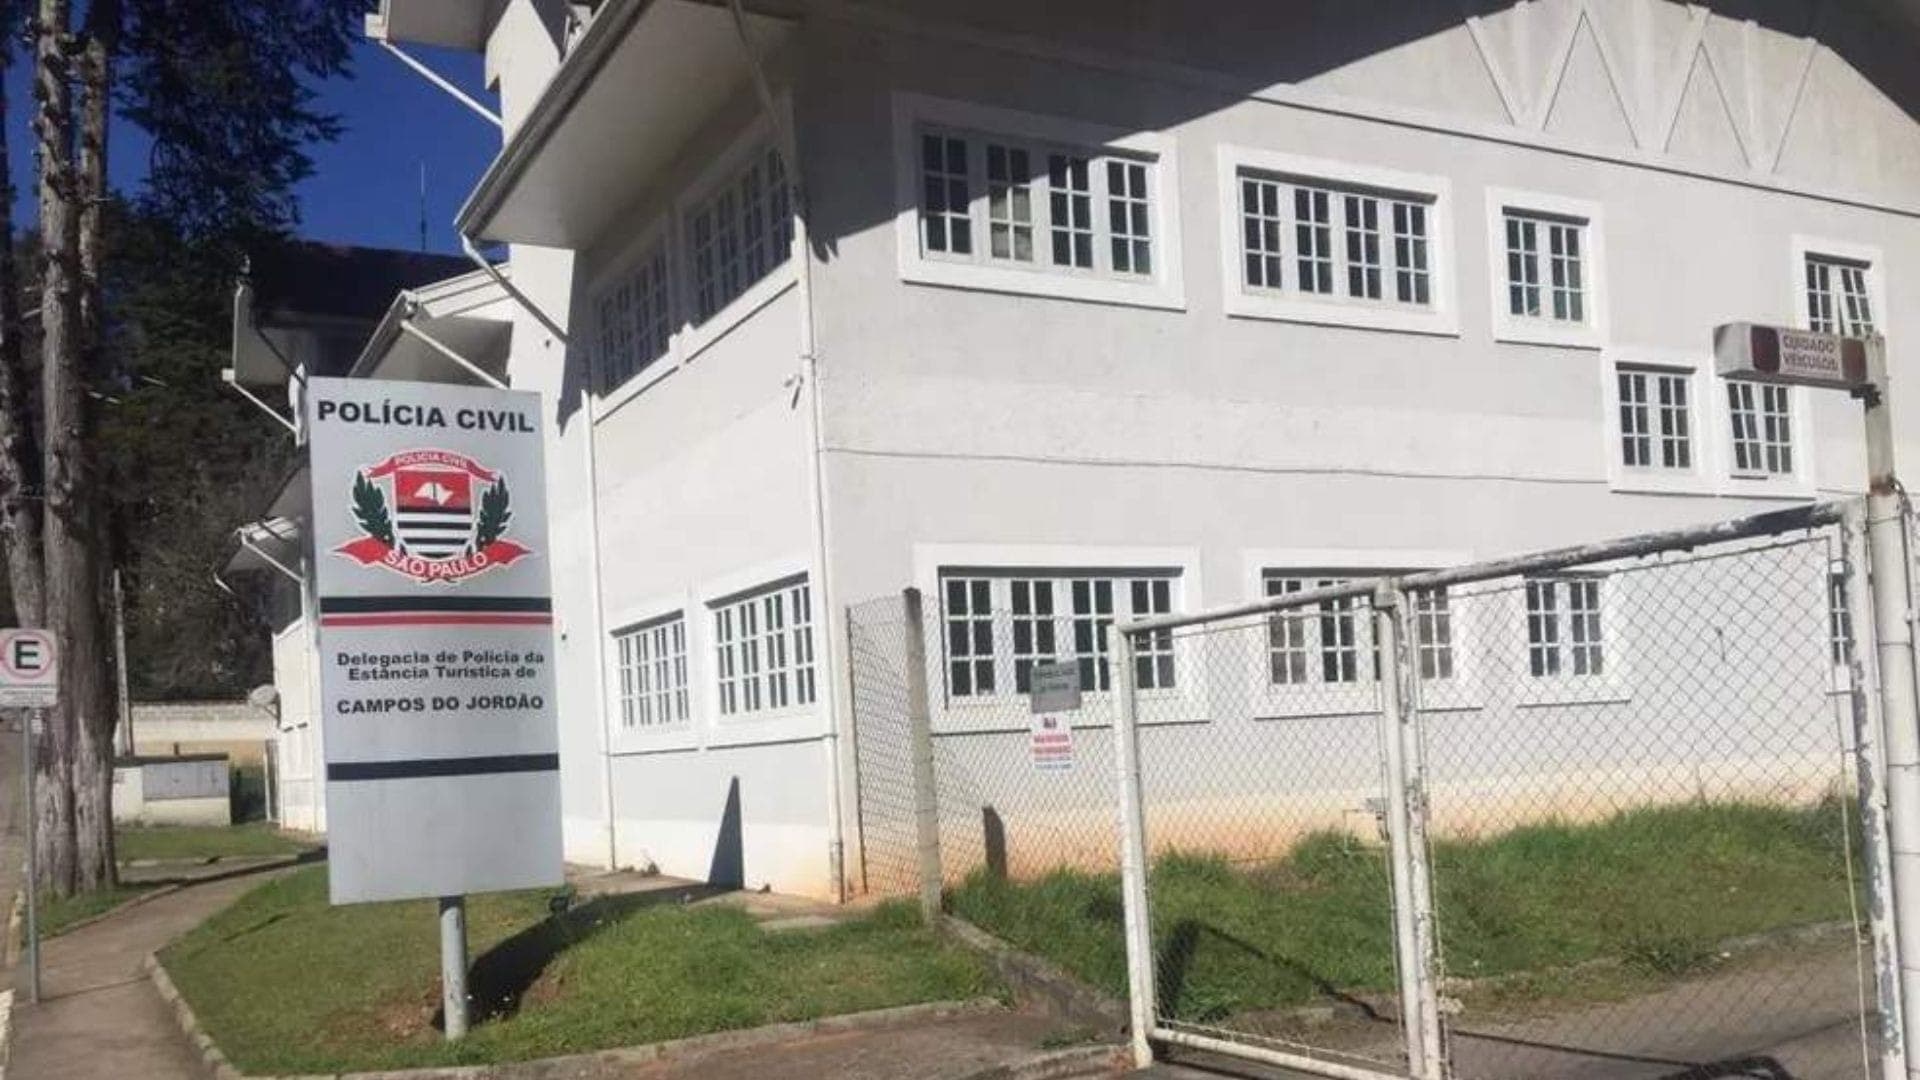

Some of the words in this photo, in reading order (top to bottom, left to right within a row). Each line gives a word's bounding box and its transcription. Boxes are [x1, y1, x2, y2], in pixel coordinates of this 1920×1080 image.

[318, 399, 446, 427] POLÍCIA
[457, 409, 535, 432] CIVIL
[429, 551, 487, 577] PAULO
[15, 640, 40, 669] E
[337, 652, 430, 667] Delegacia
[436, 651, 457, 663] de
[524, 651, 544, 663] da
[349, 667, 429, 681] Estância
[515, 665, 537, 678] de
[337, 698, 425, 714] CAMPOS
[432, 696, 459, 711] DO
[466, 693, 543, 711] JORDÃO
